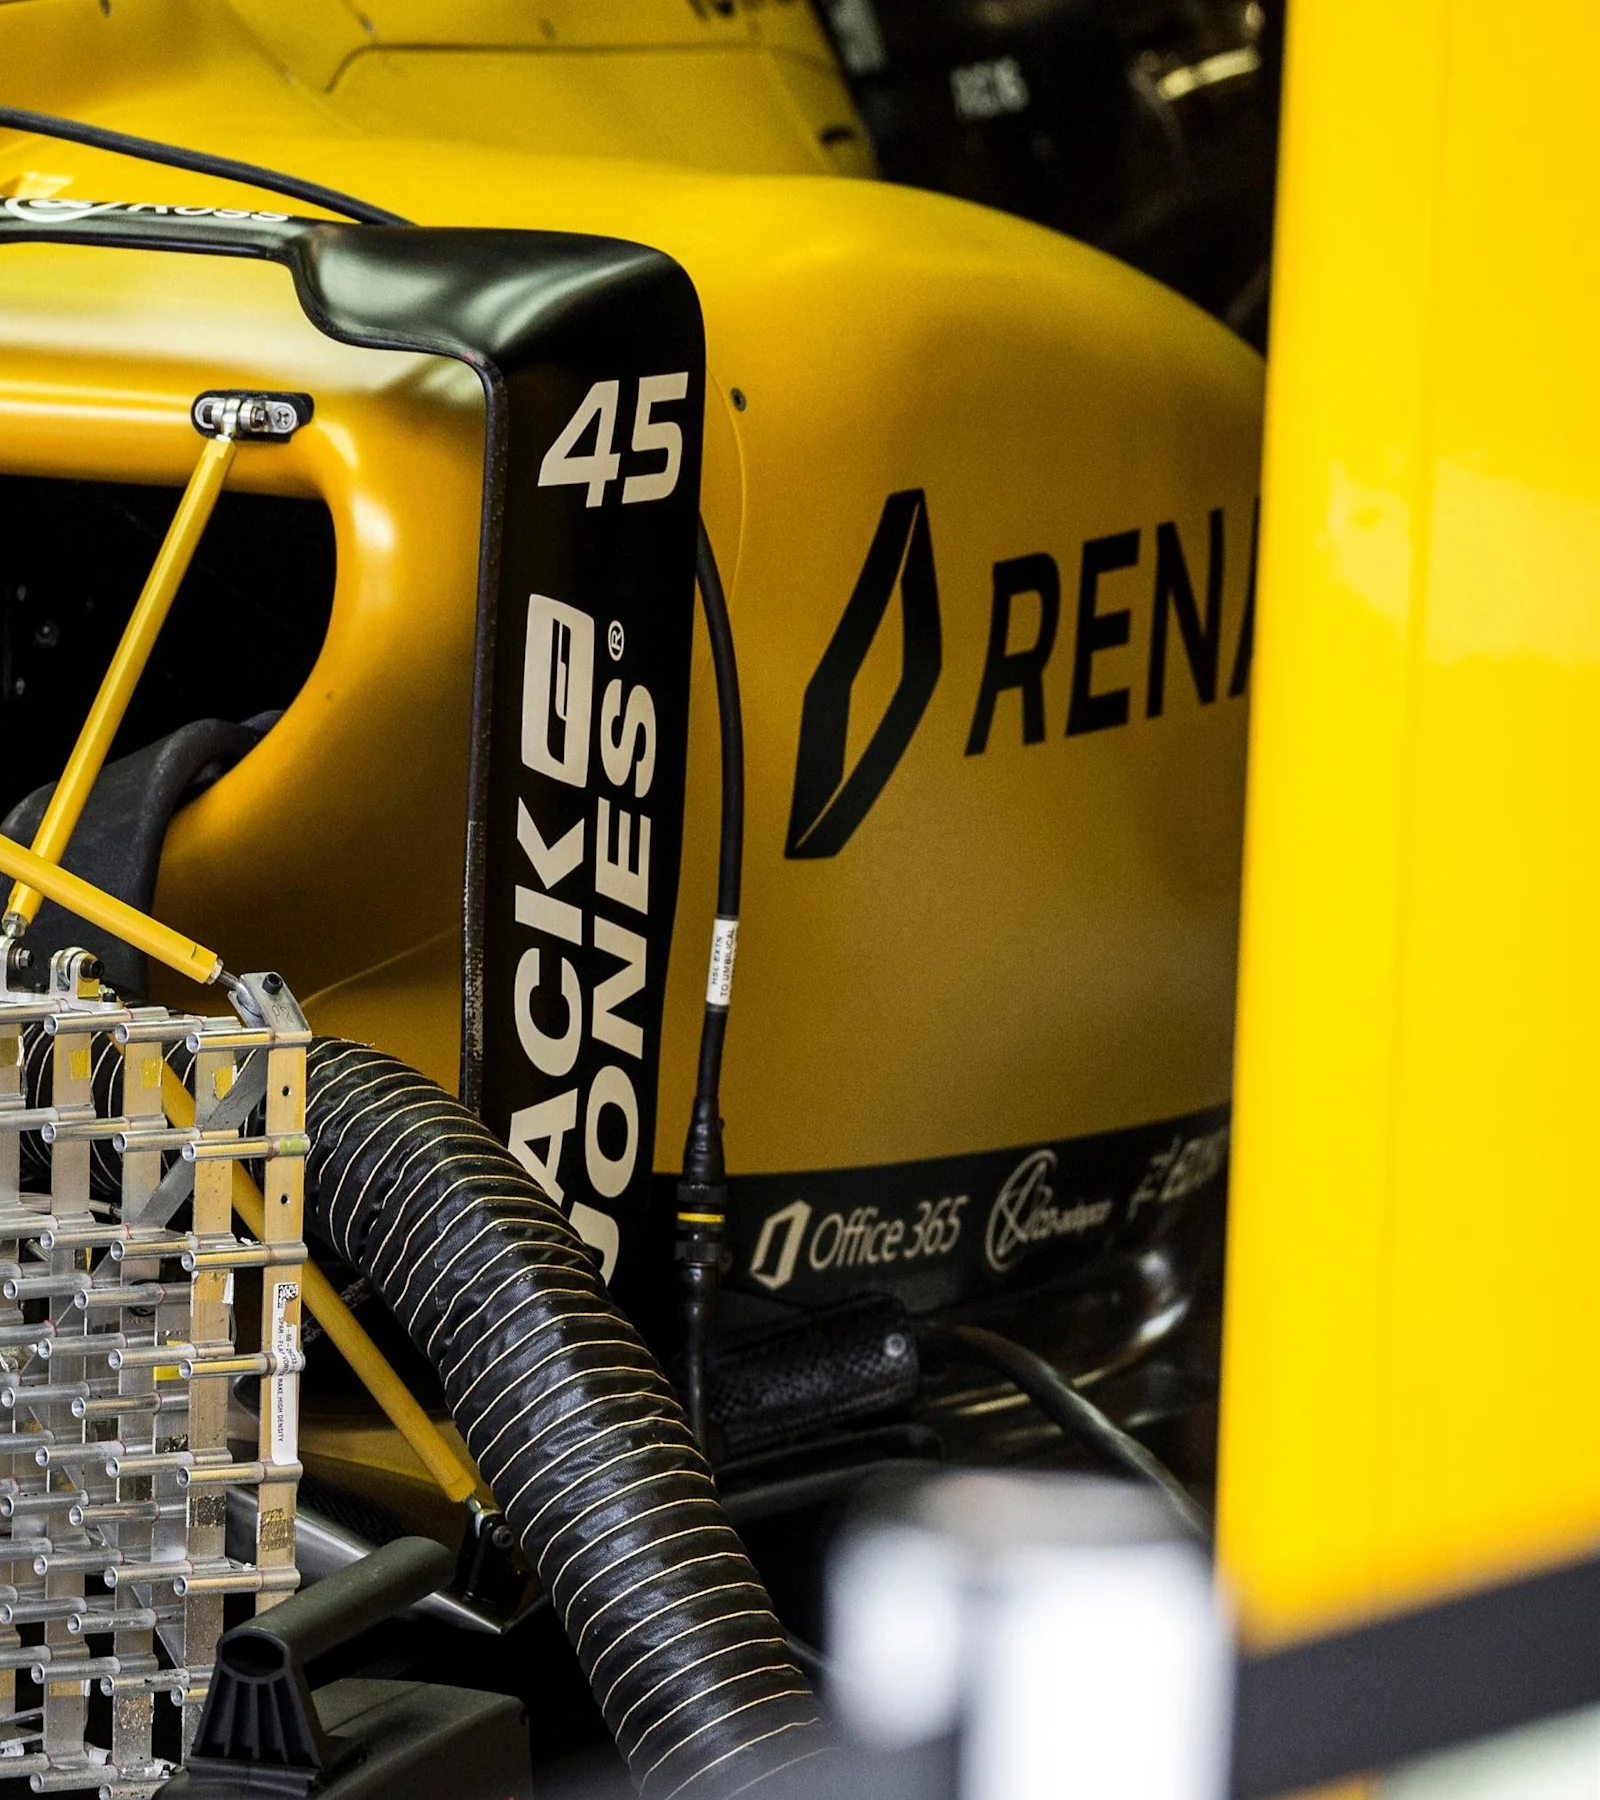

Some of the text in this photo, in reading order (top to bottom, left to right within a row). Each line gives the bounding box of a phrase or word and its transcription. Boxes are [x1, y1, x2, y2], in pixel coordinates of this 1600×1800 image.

[537, 371, 689, 508] 45
[508, 796, 586, 1208] ACK
[720, 928, 735, 997] TO UMBILICAL
[809, 1205, 905, 1271] Office
[903, 1195, 969, 1259] 365
